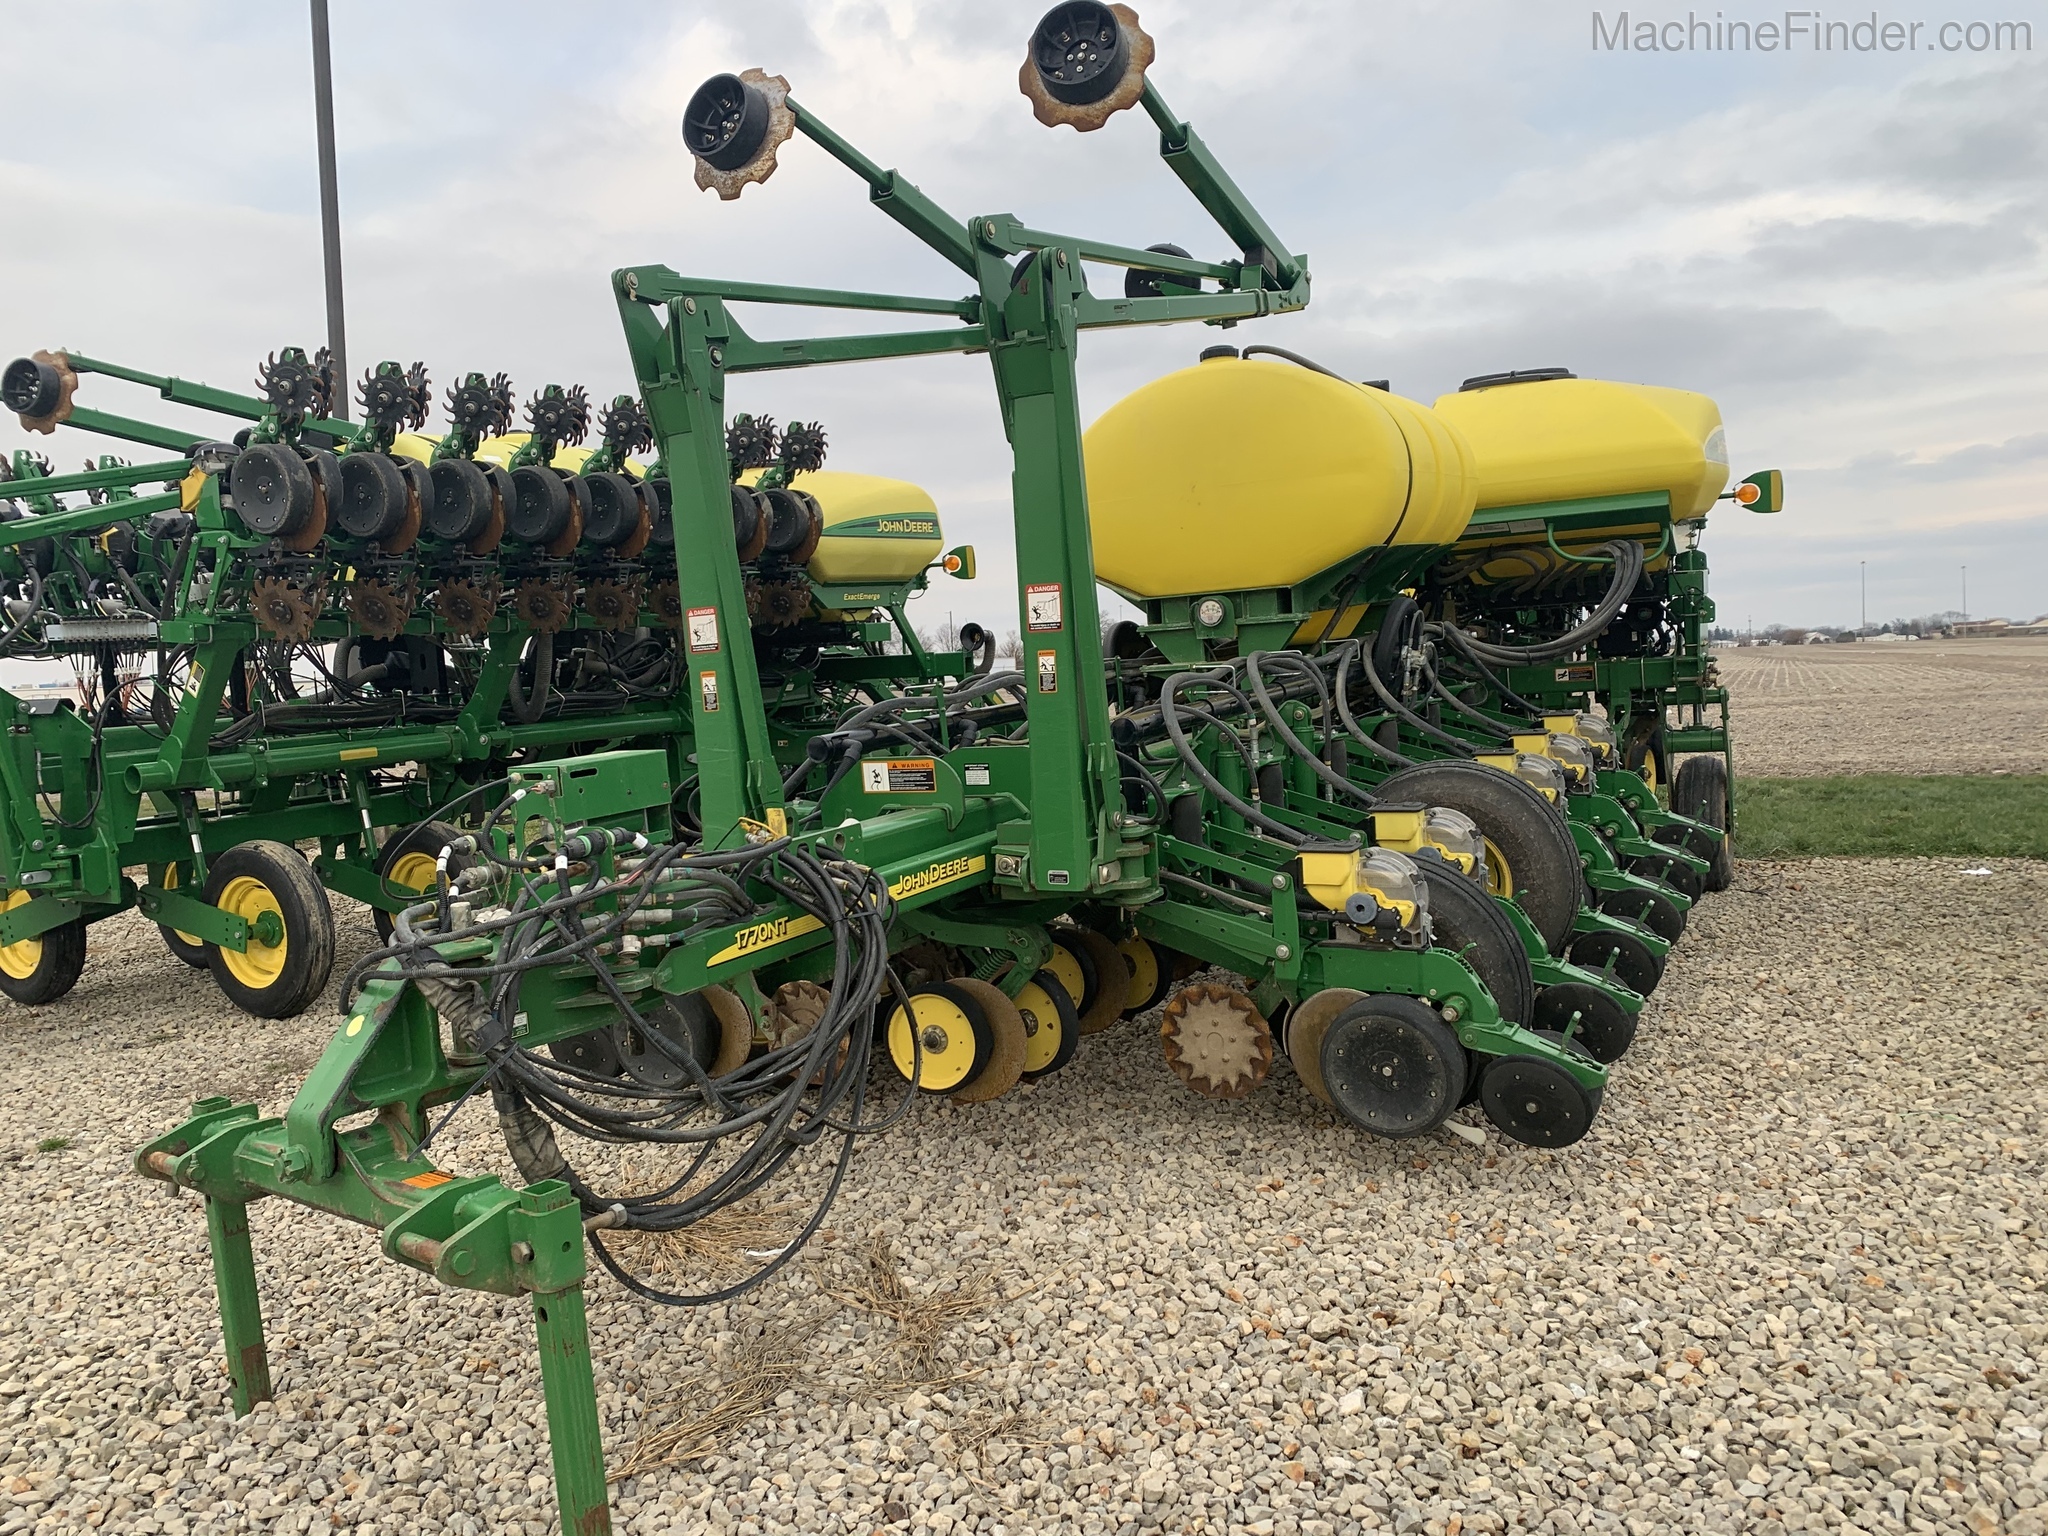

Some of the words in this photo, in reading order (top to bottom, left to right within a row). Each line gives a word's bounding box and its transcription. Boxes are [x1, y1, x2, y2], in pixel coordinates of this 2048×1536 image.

[877, 519, 903, 532] JOHN
[904, 519, 934, 533] DEERE
[843, 592, 880, 601] ExactEmerge
[896, 869, 929, 894] JOHN
[930, 856, 968, 882] DEERE
[735, 916, 789, 949] 1770NT
